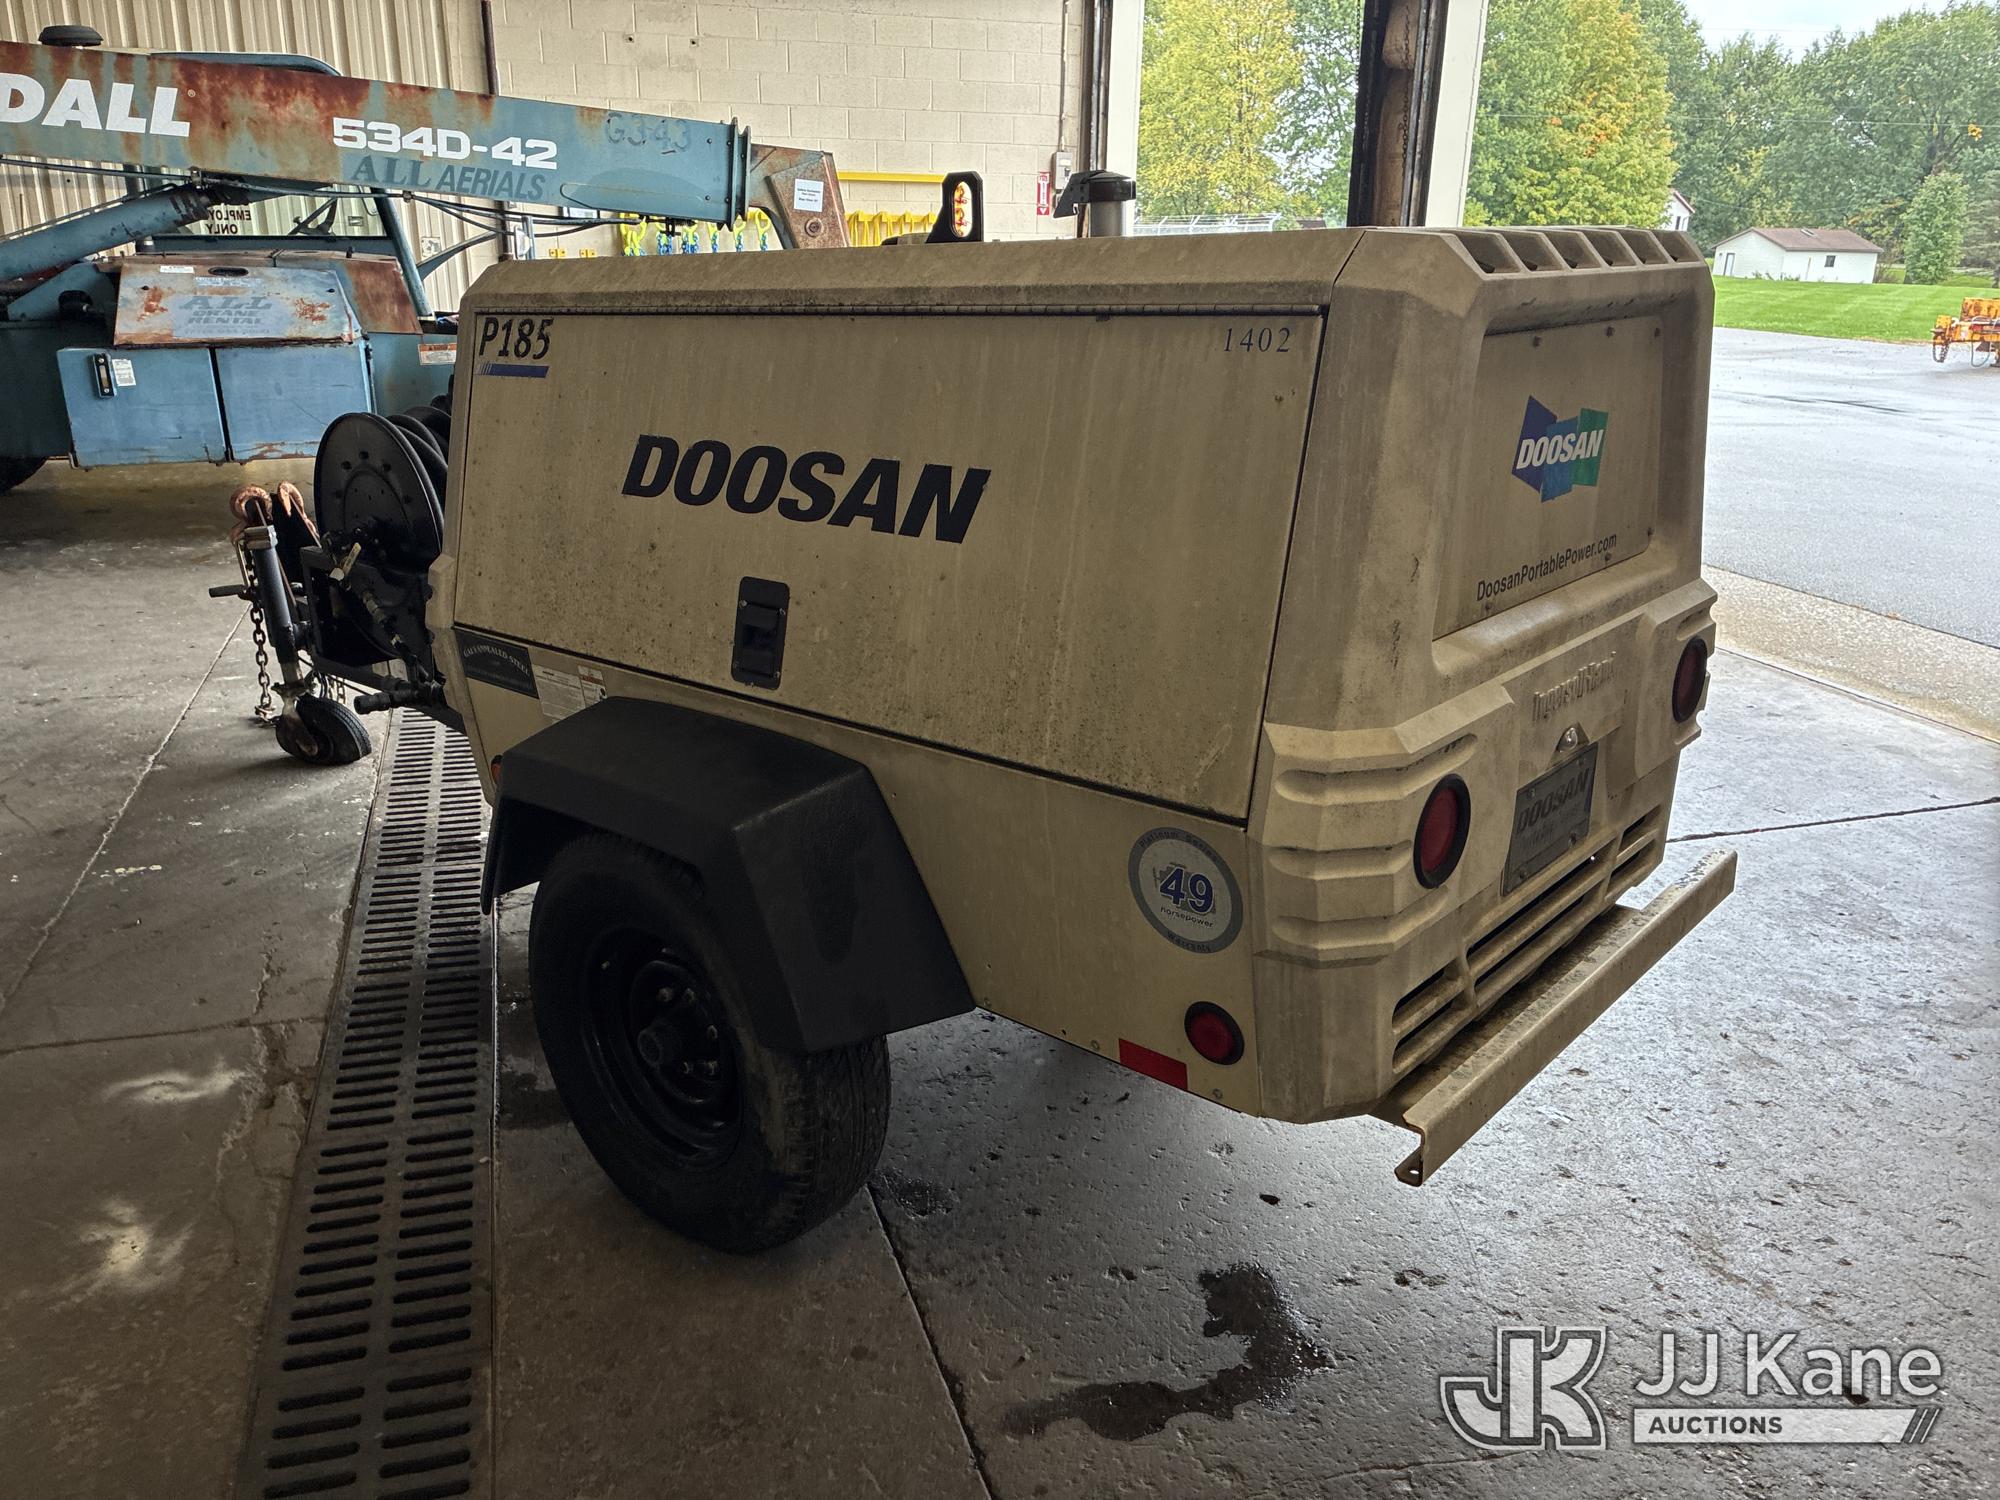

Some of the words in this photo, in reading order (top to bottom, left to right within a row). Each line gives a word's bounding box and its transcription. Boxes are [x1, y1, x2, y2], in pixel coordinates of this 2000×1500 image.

[332, 118, 557, 169] 534D-42
[350, 155, 432, 188] ALL
[437, 164, 547, 200] AERIALS
[479, 317, 554, 361] P185
[1224, 327, 1291, 354] 1402
[1516, 428, 1604, 470] DOOSAN
[622, 434, 990, 543] DOOSAN
[1476, 532, 1617, 603] DoosanPortablePower.com
[1517, 768, 1590, 834] DOOSAN
[1159, 867, 1214, 916] 49
[1160, 906, 1214, 929] horsepower
